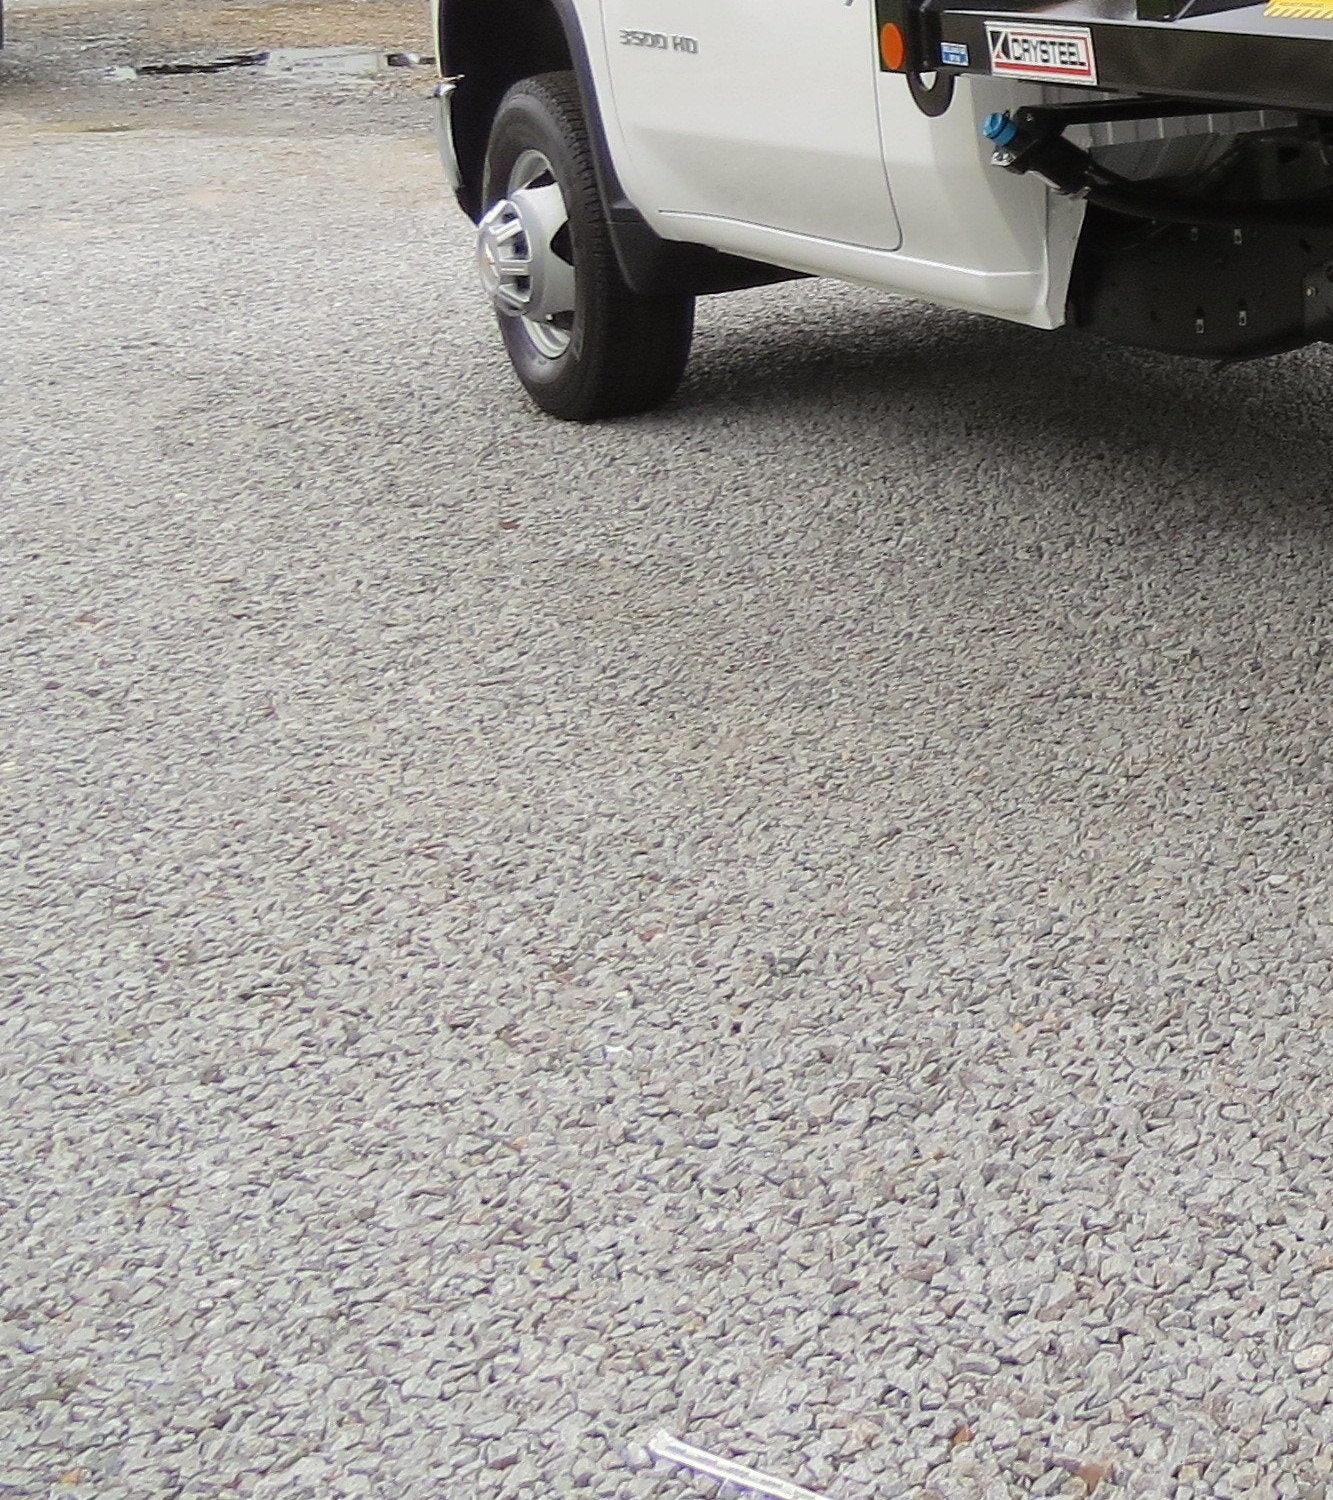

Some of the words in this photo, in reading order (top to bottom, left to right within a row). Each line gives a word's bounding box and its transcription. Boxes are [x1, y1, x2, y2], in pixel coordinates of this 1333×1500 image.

[619, 29, 668, 50] 3500
[671, 34, 699, 54] HD
[1012, 37, 1086, 67] CRYSTEEL
